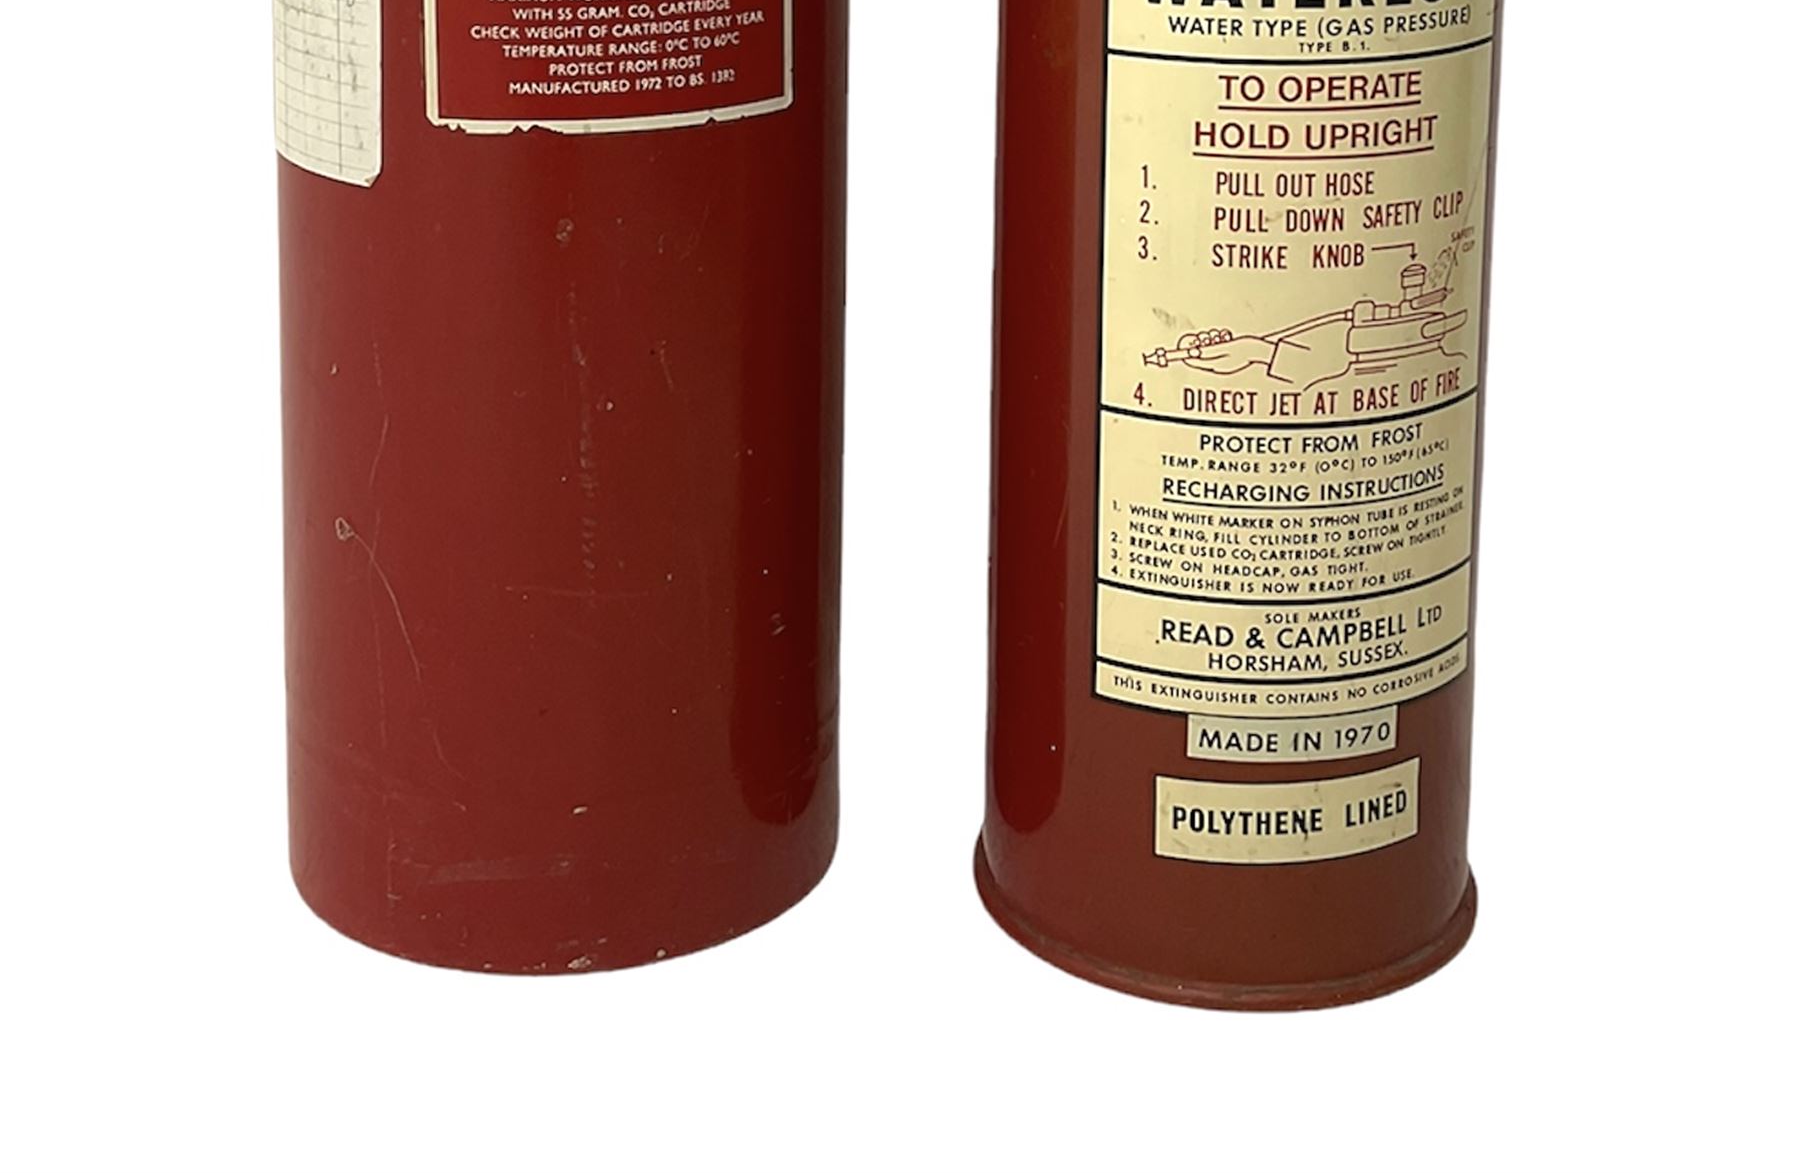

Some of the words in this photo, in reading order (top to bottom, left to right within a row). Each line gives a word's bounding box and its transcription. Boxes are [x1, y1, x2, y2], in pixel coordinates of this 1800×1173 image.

[470, 26, 519, 39] CHECK
[525, 26, 582, 39] WEIGHT
[588, 25, 608, 38] OF
[614, 20, 690, 37] CARTRIDGE
[694, 15, 733, 31] EVERY
[736, 11, 764, 25] YEAR
[513, 8, 552, 20] WITH
[557, 8, 573, 19] 55
[1169, 16, 1242, 36] WATER
[1252, 19, 1307, 37] TYPE
[1318, 17, 1374, 39] (GAS
[1384, 5, 1471, 34] PRESSURE)
[502, 43, 603, 57] TEMPERATURE
[609, 41, 662, 55] RANGE:
[693, 36, 712, 48] TO
[1299, 42, 1332, 53] TYPE
[549, 62, 613, 76] PROTECT
[619, 58, 658, 72] FROM
[662, 55, 701, 70] FROST
[509, 80, 630, 95] MANUFACTURED
[636, 78, 661, 90] 1972
[666, 76, 685, 88] TO
[1218, 76, 1265, 101] TO
[1278, 71, 1422, 101] OPERATE
[1195, 122, 1289, 149] HOLD
[1305, 116, 1438, 150] UPRIGHT
[1141, 165, 1156, 189] 1.
[1216, 172, 1264, 197] PULL
[1276, 174, 1316, 197] OUT
[1326, 171, 1374, 196] HOSE
[1140, 200, 1158, 225] 2.
[1214, 208, 1268, 232] PULL
[1286, 208, 1344, 232] DOWN
[1363, 200, 1422, 229] SAFETY
[1433, 191, 1463, 219] CLIP
[1138, 236, 1157, 260] 3.
[1212, 245, 1288, 269] STRIKE
[1312, 244, 1364, 268] KNOB
[1133, 382, 1152, 407] 4.
[1184, 388, 1258, 414] DIRECT
[1269, 394, 1301, 416] JET
[1314, 392, 1338, 415] AT
[1353, 385, 1399, 412] BASE
[1411, 377, 1428, 402] OF
[1436, 368, 1460, 395] FIRE
[1200, 434, 1292, 454] PROTECT
[1302, 434, 1358, 454] FROM
[1372, 423, 1422, 449] FROST
[1162, 479, 1309, 503] RECHARGING
[1320, 464, 1444, 500] INSTRUCTIONS
[1112, 501, 1121, 512] 1.
[1129, 504, 1168, 522] WHEN
[1172, 510, 1214, 526] WHITE
[1219, 515, 1273, 529] MARKER
[1280, 517, 1302, 529] ON
[1310, 514, 1359, 529] SYPHON
[1367, 507, 1394, 522] TUBE
[1399, 505, 1408, 516] IS
[1111, 549, 1122, 560] 3.
[1129, 553, 1172, 569] SCREW
[1181, 560, 1202, 572] ON
[1213, 564, 1284, 577] HEADCAP,
[1290, 564, 1318, 576] GAS
[1328, 562, 1367, 574] TIGHT.
[1111, 565, 1122, 577] 4.
[1129, 569, 1231, 592] EXTINGUISHER
[1241, 581, 1254, 592] IS
[1262, 582, 1299, 594] NOW
[1308, 579, 1354, 592] READY
[1362, 575, 1386, 587] FOR
[1392, 569, 1414, 582] USE.
[1265, 612, 1299, 624] SOLE
[1308, 608, 1361, 622] MAKERS
[1162, 619, 1234, 646] READ
[1246, 630, 1266, 649] &
[1277, 614, 1407, 649] CAMPBELL
[1208, 653, 1329, 672] HORSHAM,
[1338, 642, 1408, 668] SUSSEX.
[1114, 676, 1142, 691] THIS
[1151, 684, 1257, 704] EXTINGUISHER
[1266, 690, 1338, 704] CONTAINS
[1347, 687, 1366, 699] NO
[1199, 730, 1278, 752] MADE
[1292, 731, 1321, 751] IN
[1335, 722, 1391, 749] 1970
[1172, 806, 1322, 836] POLYTHENE
[1345, 789, 1407, 828] LINED
